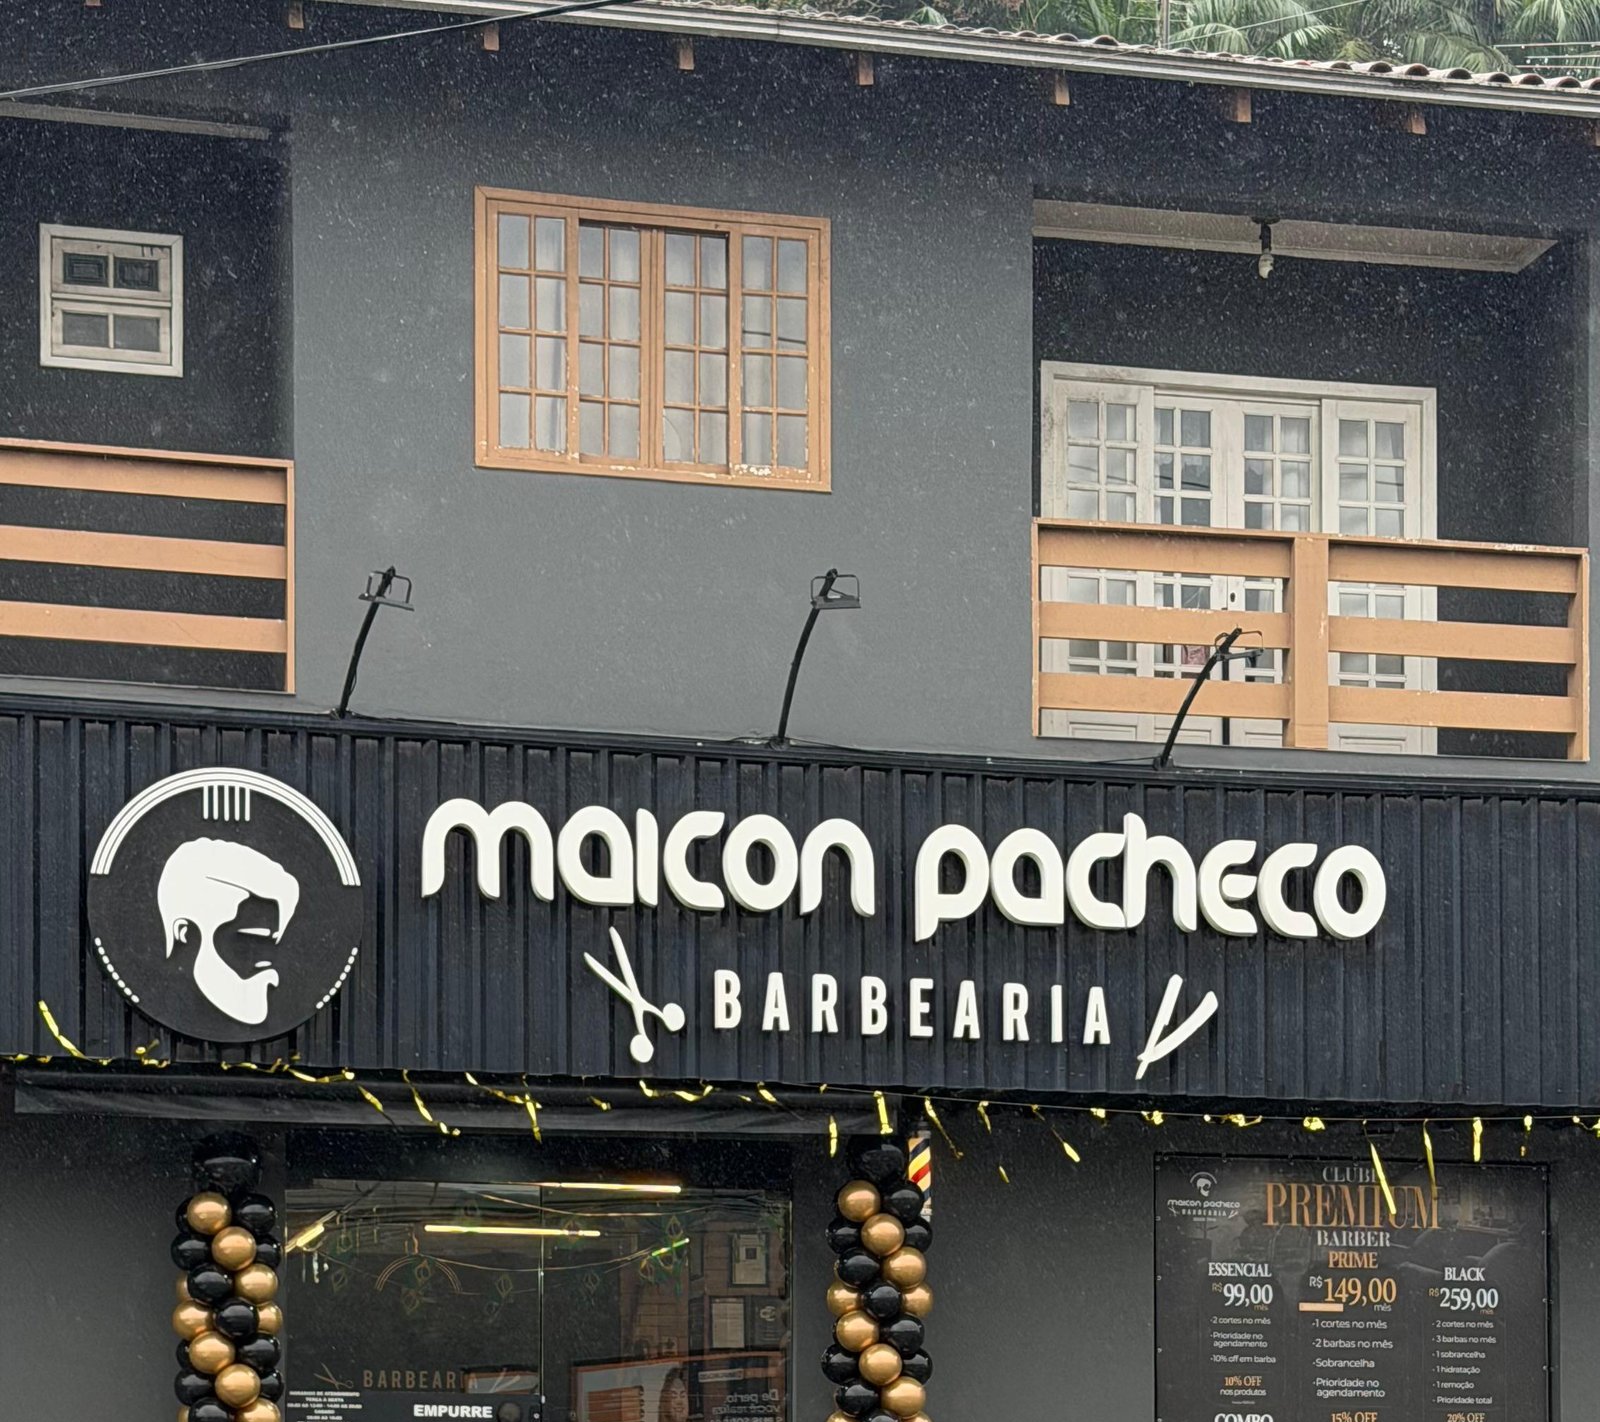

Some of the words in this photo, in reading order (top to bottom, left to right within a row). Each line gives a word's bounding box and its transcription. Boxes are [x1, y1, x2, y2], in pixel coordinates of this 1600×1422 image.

[713, 969, 1111, 1046] BARBEARIA
[1263, 1182, 1442, 1229] PREMIUM
[1317, 1230, 1391, 1247] BARBER
[1328, 1251, 1378, 1268] PRIME
[1208, 1262, 1272, 1278] ESSENCIAL
[1444, 1267, 1486, 1281] BLACK
[1324, 1277, 1397, 1306] 149,00
[1440, 1287, 1499, 1311] 259,00
[1374, 1304, 1392, 1312] mês
[1254, 1317, 1271, 1325] mês
[1321, 1320, 1350, 1328] cortes
[1366, 1320, 1387, 1329] mês
[1477, 1321, 1494, 1329] mês
[1213, 1340, 1268, 1348] agendamento
[1323, 1339, 1356, 1348] barbas
[1372, 1340, 1393, 1349] mês
[1442, 1335, 1467, 1343] barbas
[1480, 1336, 1497, 1344] mês
[1254, 1355, 1276, 1363] barba
[1440, 1351, 1486, 1359] sobrancelha
[1440, 1366, 1480, 1374] hidratação
[1224, 1376, 1242, 1386] 10%
[1243, 1376, 1262, 1386] OFF
[1441, 1381, 1474, 1389] remoção
[1234, 1388, 1267, 1397] produtos
[1317, 1388, 1385, 1398] agendamento
[1437, 1396, 1474, 1404] Prioridade
[413, 1404, 493, 1419] EMPURRE
[1447, 1413, 1466, 1422] 20%
[1467, 1413, 1486, 1422] OFF
